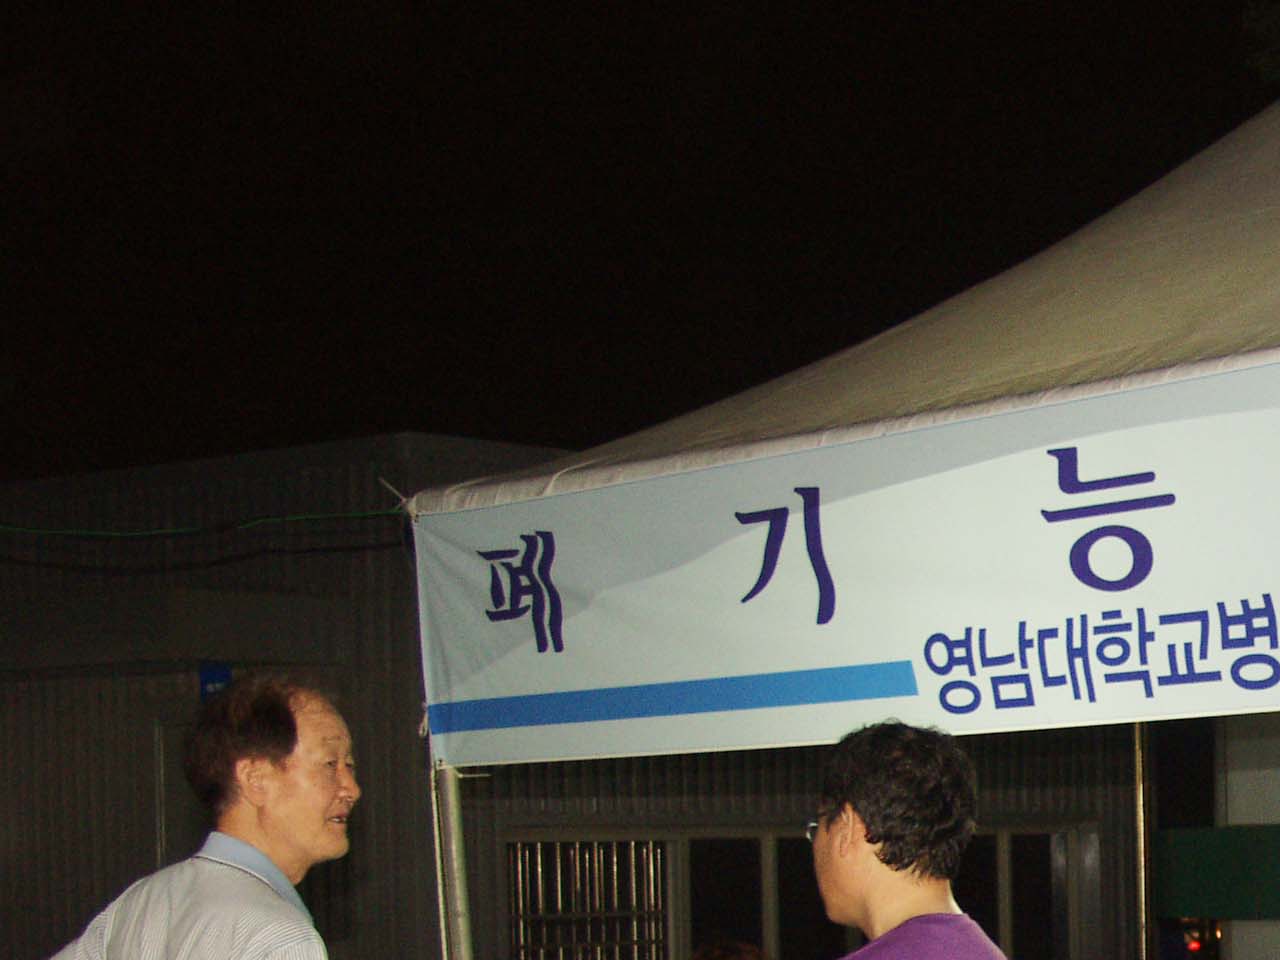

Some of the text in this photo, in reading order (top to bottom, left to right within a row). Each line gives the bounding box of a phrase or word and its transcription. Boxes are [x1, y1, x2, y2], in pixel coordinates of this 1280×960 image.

[477, 531, 564, 654] 폐
[734, 486, 836, 625] 기
[1041, 446, 1176, 593] 능
